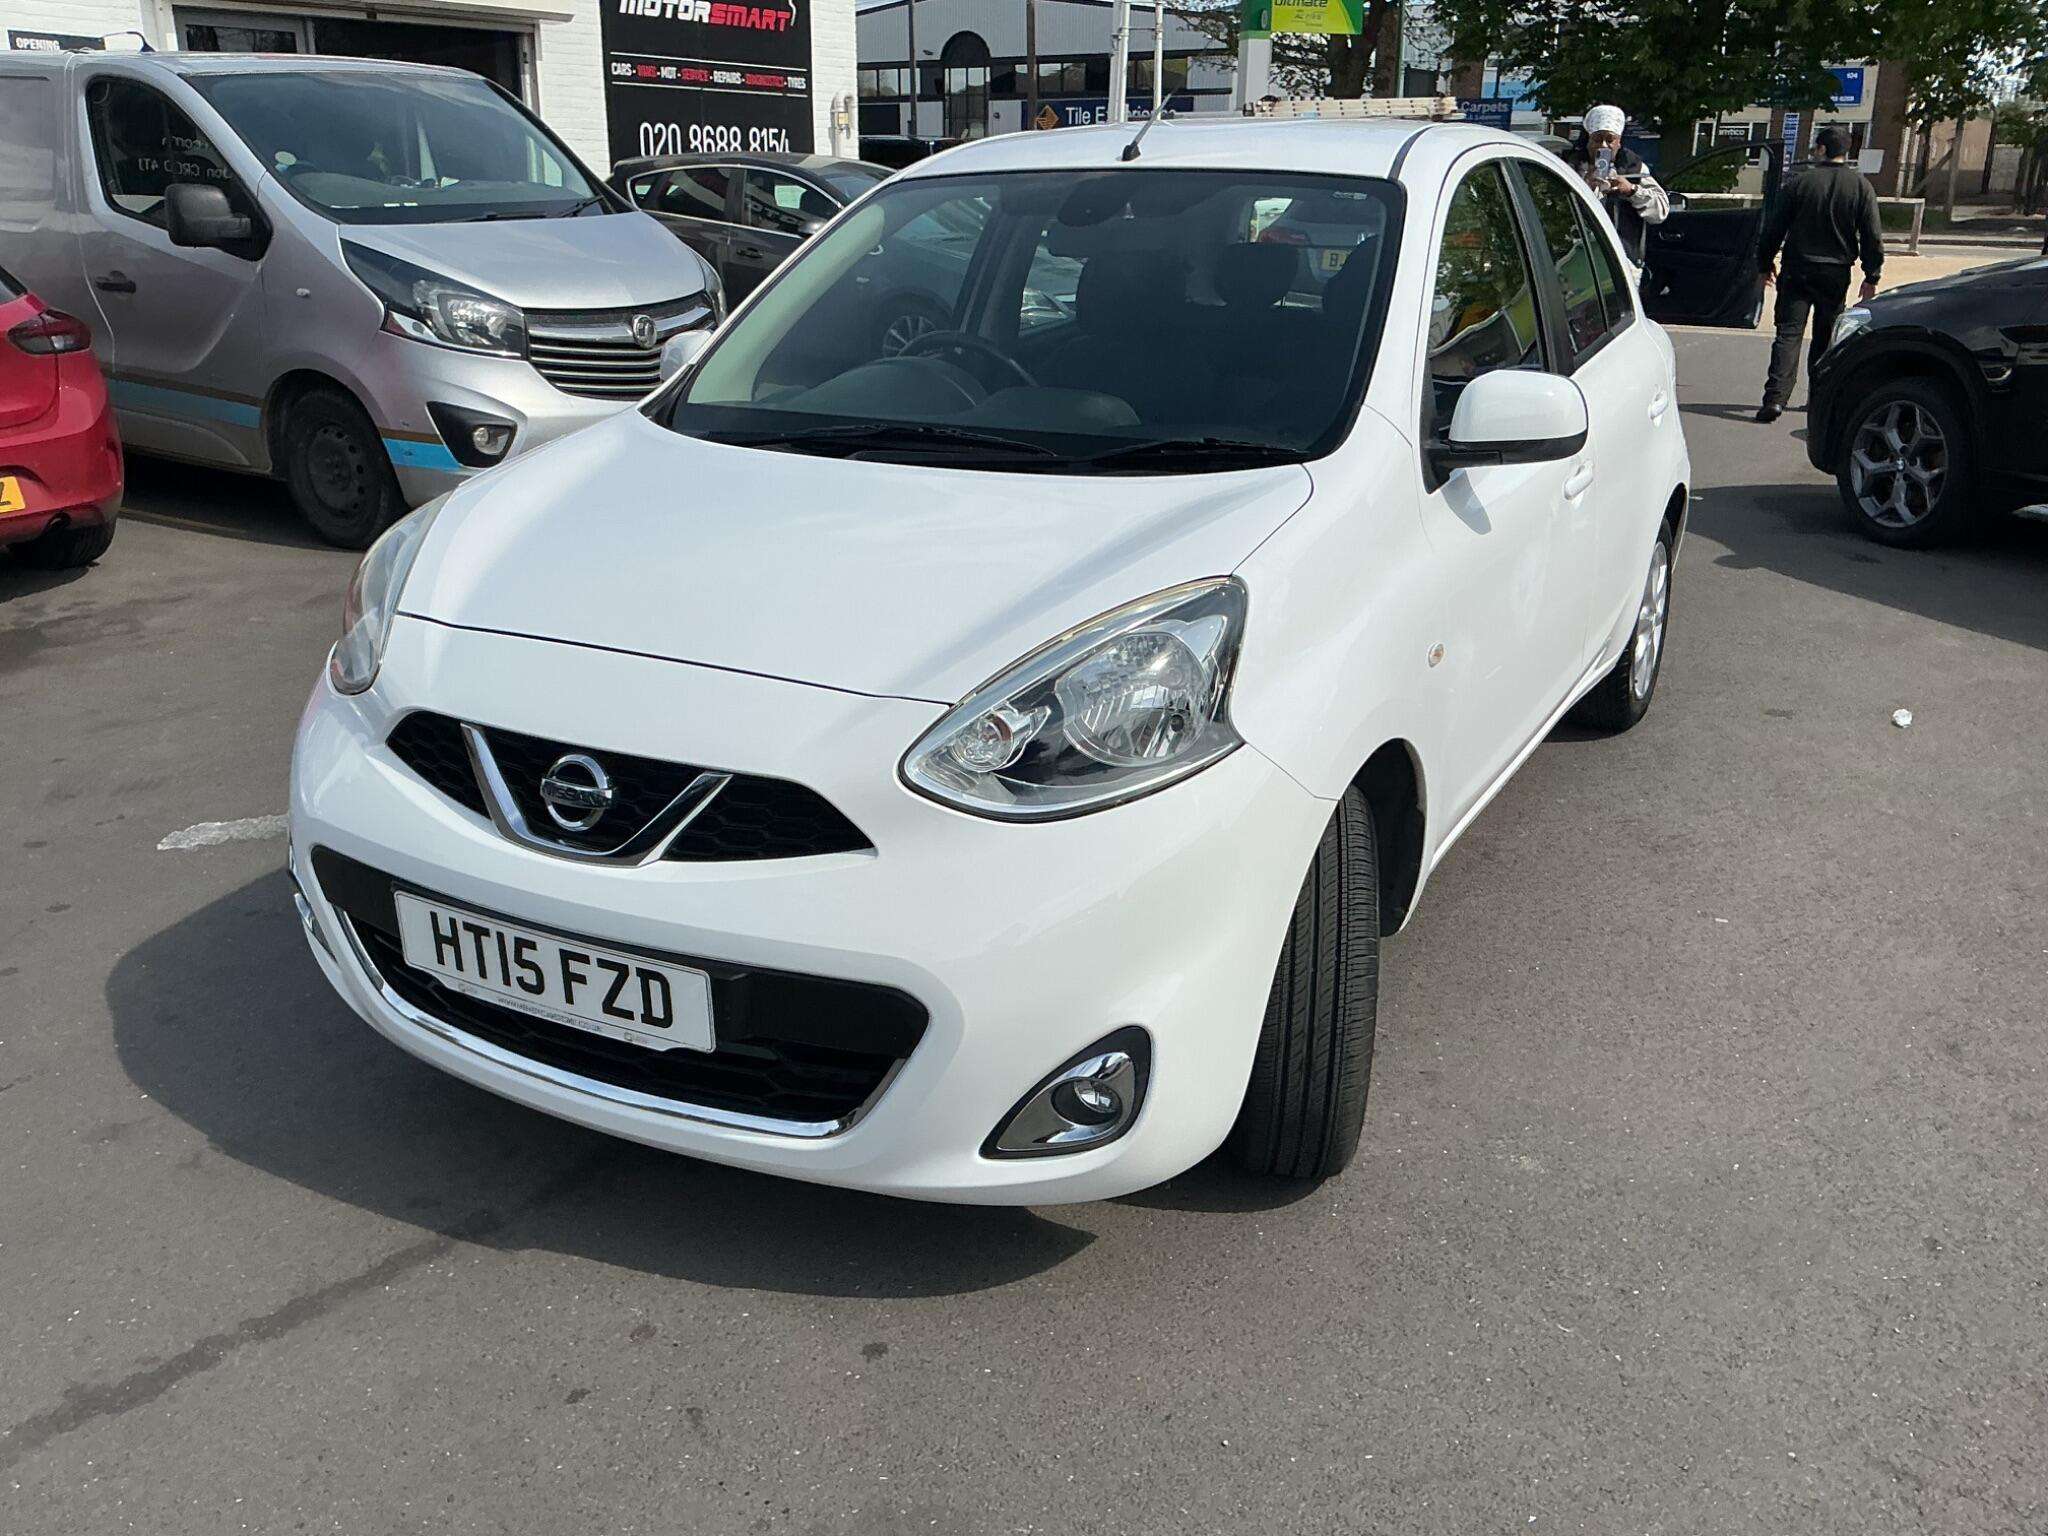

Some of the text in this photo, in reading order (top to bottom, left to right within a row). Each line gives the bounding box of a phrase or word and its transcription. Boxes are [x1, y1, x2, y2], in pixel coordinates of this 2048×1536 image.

[618, 0, 792, 32] MOTORSMART
[15, 37, 60, 51] OPENING
[611, 62, 632, 76] CARS
[713, 70, 742, 84] REPAIRS
[1066, 106, 1091, 125] Tile
[1461, 101, 1510, 114] Carpets
[639, 122, 790, 158] 020 8688 8154
[430, 911, 545, 995] HT15
[559, 948, 674, 1029] FZD
